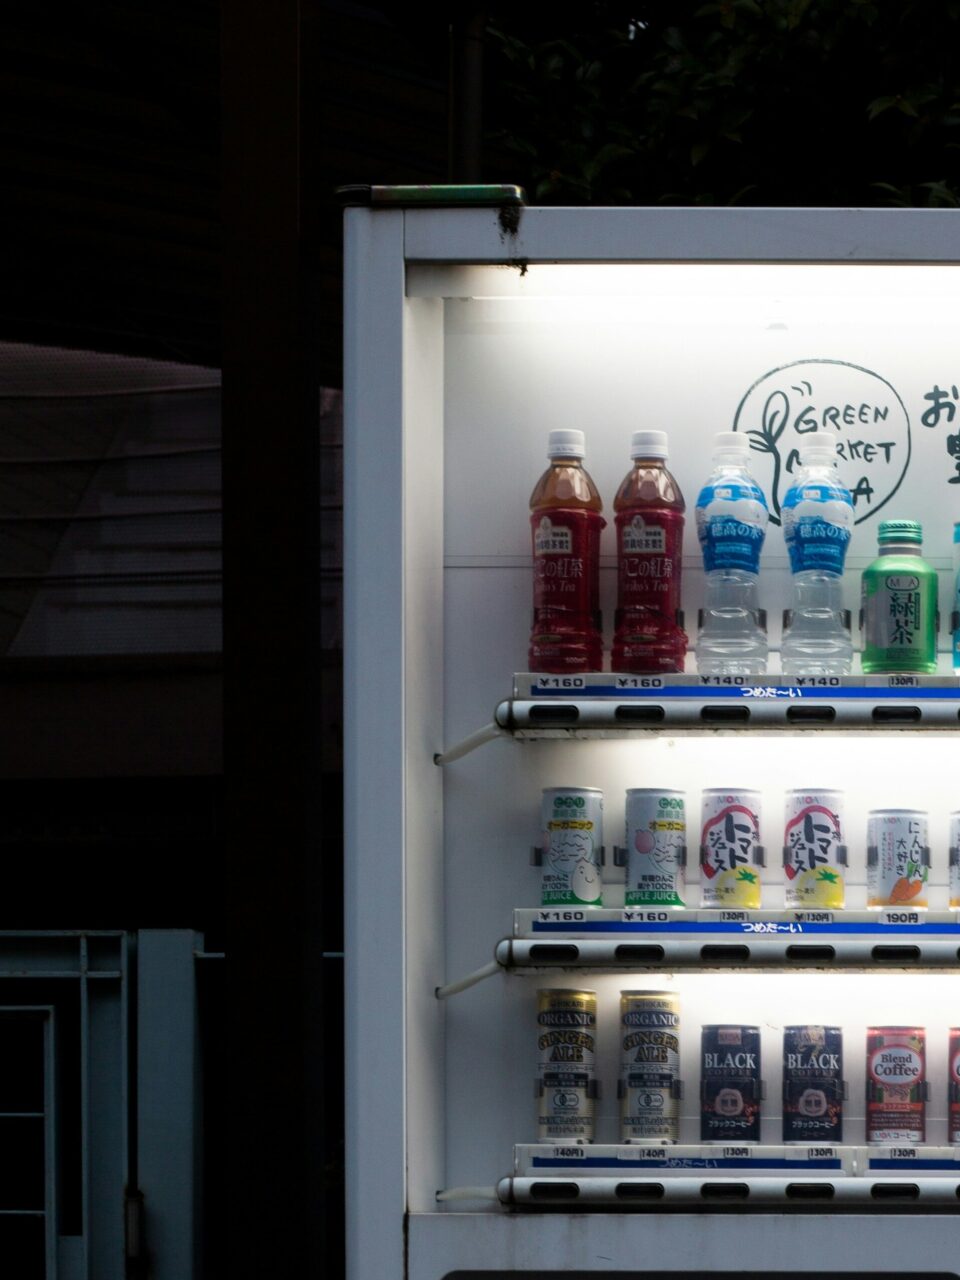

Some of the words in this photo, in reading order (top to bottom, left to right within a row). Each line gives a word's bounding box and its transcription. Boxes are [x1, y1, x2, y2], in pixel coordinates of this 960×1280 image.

[794, 405, 889, 434] GREEN
[785, 441, 896, 474] MRKET
[653, 580, 668, 591] Tea
[889, 592, 914, 645] 緑茶
[539, 678, 583, 687] ¥160
[618, 678, 662, 687] ¥160
[701, 676, 744, 685] ¥140
[795, 677, 839, 686] ¥140
[890, 677, 914, 685] 130円
[548, 821, 593, 830] オーガニック
[725, 813, 751, 869] トマト
[804, 814, 831, 869] トマト
[709, 830, 727, 871] ジュース
[790, 831, 808, 872] ジュース
[908, 821, 923, 878] にんじん
[896, 838, 908, 876] 大好き
[638, 883, 673, 891] 果汁100%
[550, 892, 571, 900] JUICE
[628, 892, 649, 901] APPLE
[653, 892, 676, 901] JUICE
[540, 912, 583, 920] ¥160
[624, 913, 667, 921] ¥160
[722, 912, 745, 920] 130円
[806, 913, 829, 921] 130円
[886, 913, 918, 922] 190円
[539, 1013, 593, 1026] ORGANIC
[624, 1013, 679, 1026] ORGANIC
[539, 1030, 594, 1053] GINGER
[623, 1031, 679, 1054] GINGER
[549, 1045, 584, 1062] ALE
[635, 1046, 668, 1062] ALE
[881, 1055, 912, 1063] Blend
[704, 1053, 756, 1069] BLACK
[788, 1054, 839, 1069] BLACK
[874, 1064, 918, 1076] Coffee
[726, 1148, 748, 1156] 130円
[810, 1149, 833, 1157] 130円
[893, 1149, 916, 1157] 130円
